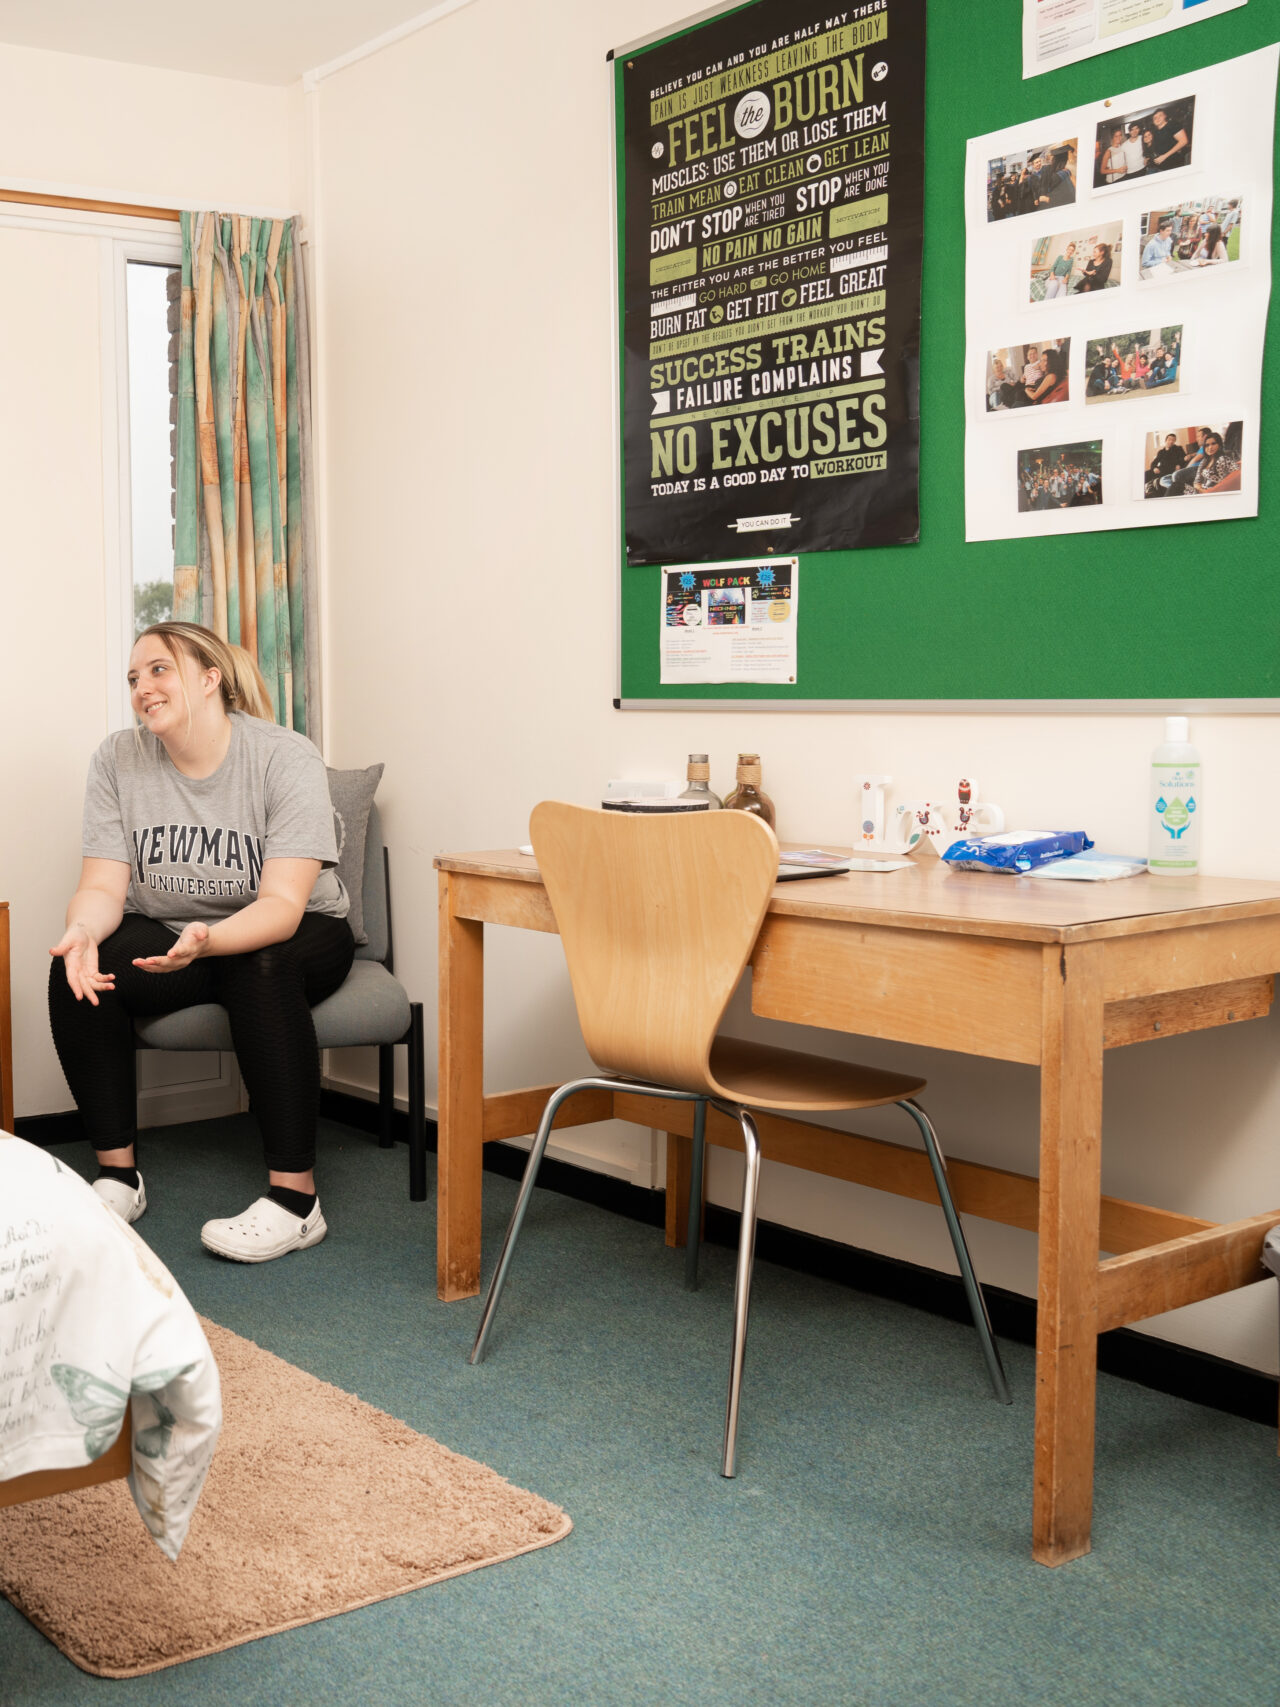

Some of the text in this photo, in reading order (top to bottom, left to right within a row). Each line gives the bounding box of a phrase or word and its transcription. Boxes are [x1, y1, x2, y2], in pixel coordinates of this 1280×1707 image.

[650, 0, 887, 99] BELIEVE YOU CAN AND YOU ARE HALF WAY THERE
[654, 18, 881, 121] PAIN IS JUST WEAKNESS LEAVING THE BODY
[668, 53, 864, 168] FEEL the BURN
[652, 101, 887, 196] MUSCLES: USE THEM OR LOSE THEM
[652, 132, 890, 220] TRAIN MEAN EAT CLEAN GET LEAN
[796, 176, 841, 212] STOP
[844, 176, 888, 198] ARE DONE
[845, 162, 889, 185] WHEN YOU
[745, 193, 785, 215] WHEN YOU
[745, 206, 785, 227] ARE TIRED
[835, 207, 880, 223] MOTIVATION
[650, 206, 742, 253] DON'T STOP
[703, 216, 822, 268] NO PAIN NO GAIN
[651, 232, 888, 299] THE FITTER YOU ARE THE BETTER YOU FEEL
[699, 262, 826, 303] GO HARD OR GO HOME
[650, 265, 887, 339] BURN FAT GET FIT FEEL GREAT
[702, 334, 710, 344] THE
[735, 325, 745, 335] YOU
[780, 314, 794, 326] FROM
[797, 311, 806, 323] THE
[809, 305, 834, 320] WORKOUT
[838, 302, 847, 313] YOU
[873, 295, 881, 306] DO
[650, 316, 886, 389] SUCCESS TRAINS
[677, 355, 852, 409] FAILURE COMPLAINS
[650, 394, 887, 478] NO EXCUSES
[651, 454, 883, 496] TODAY IS A GOOD DAY TO WORKOUT
[741, 520, 754, 528] YOU
[756, 519, 769, 527] CAN
[770, 518, 779, 526] DO
[702, 576, 751, 588] WOLF PACK
[148, 872, 245, 897] UNIVERSITY
